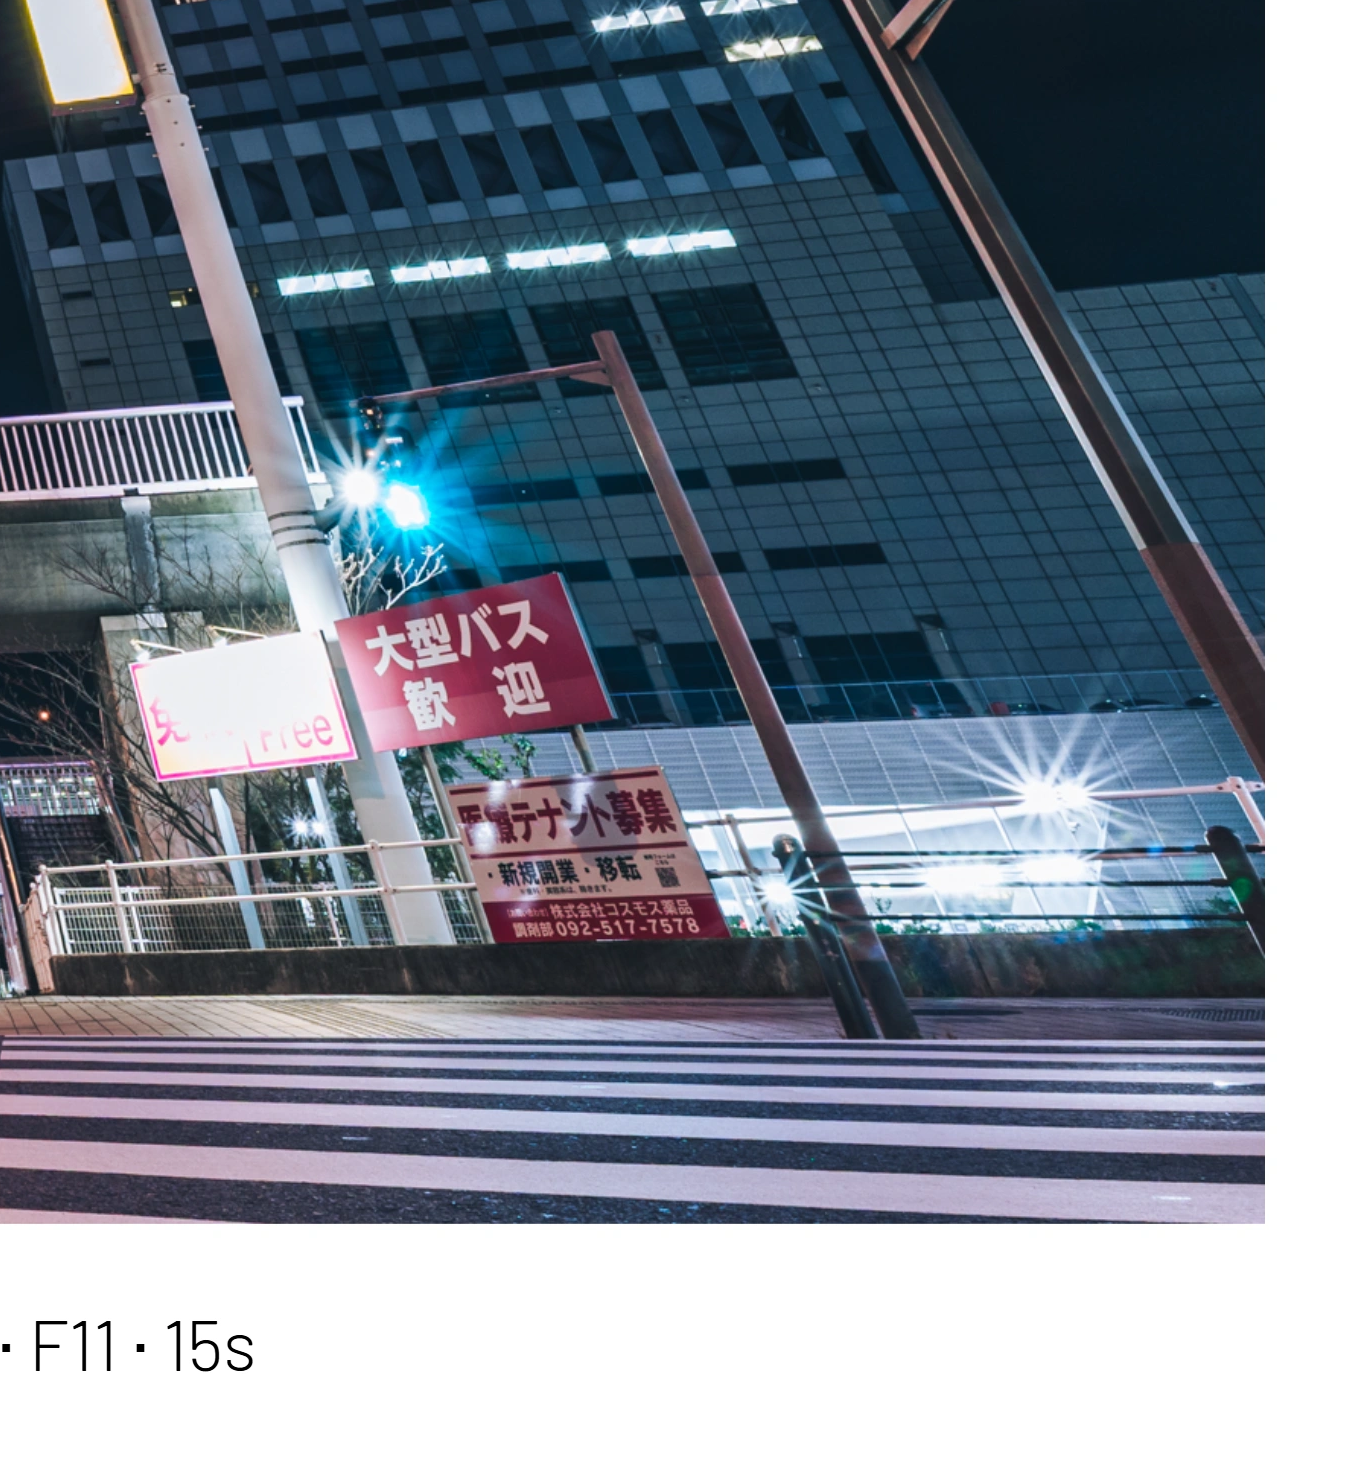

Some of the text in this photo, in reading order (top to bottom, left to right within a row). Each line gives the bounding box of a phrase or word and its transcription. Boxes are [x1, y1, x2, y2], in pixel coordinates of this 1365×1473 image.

[365, 599, 549, 677] 大型バス
[549, 899, 694, 920] 株式会社コスモス薬品
[512, 917, 700, 939] 調剤部 092-517-7578
